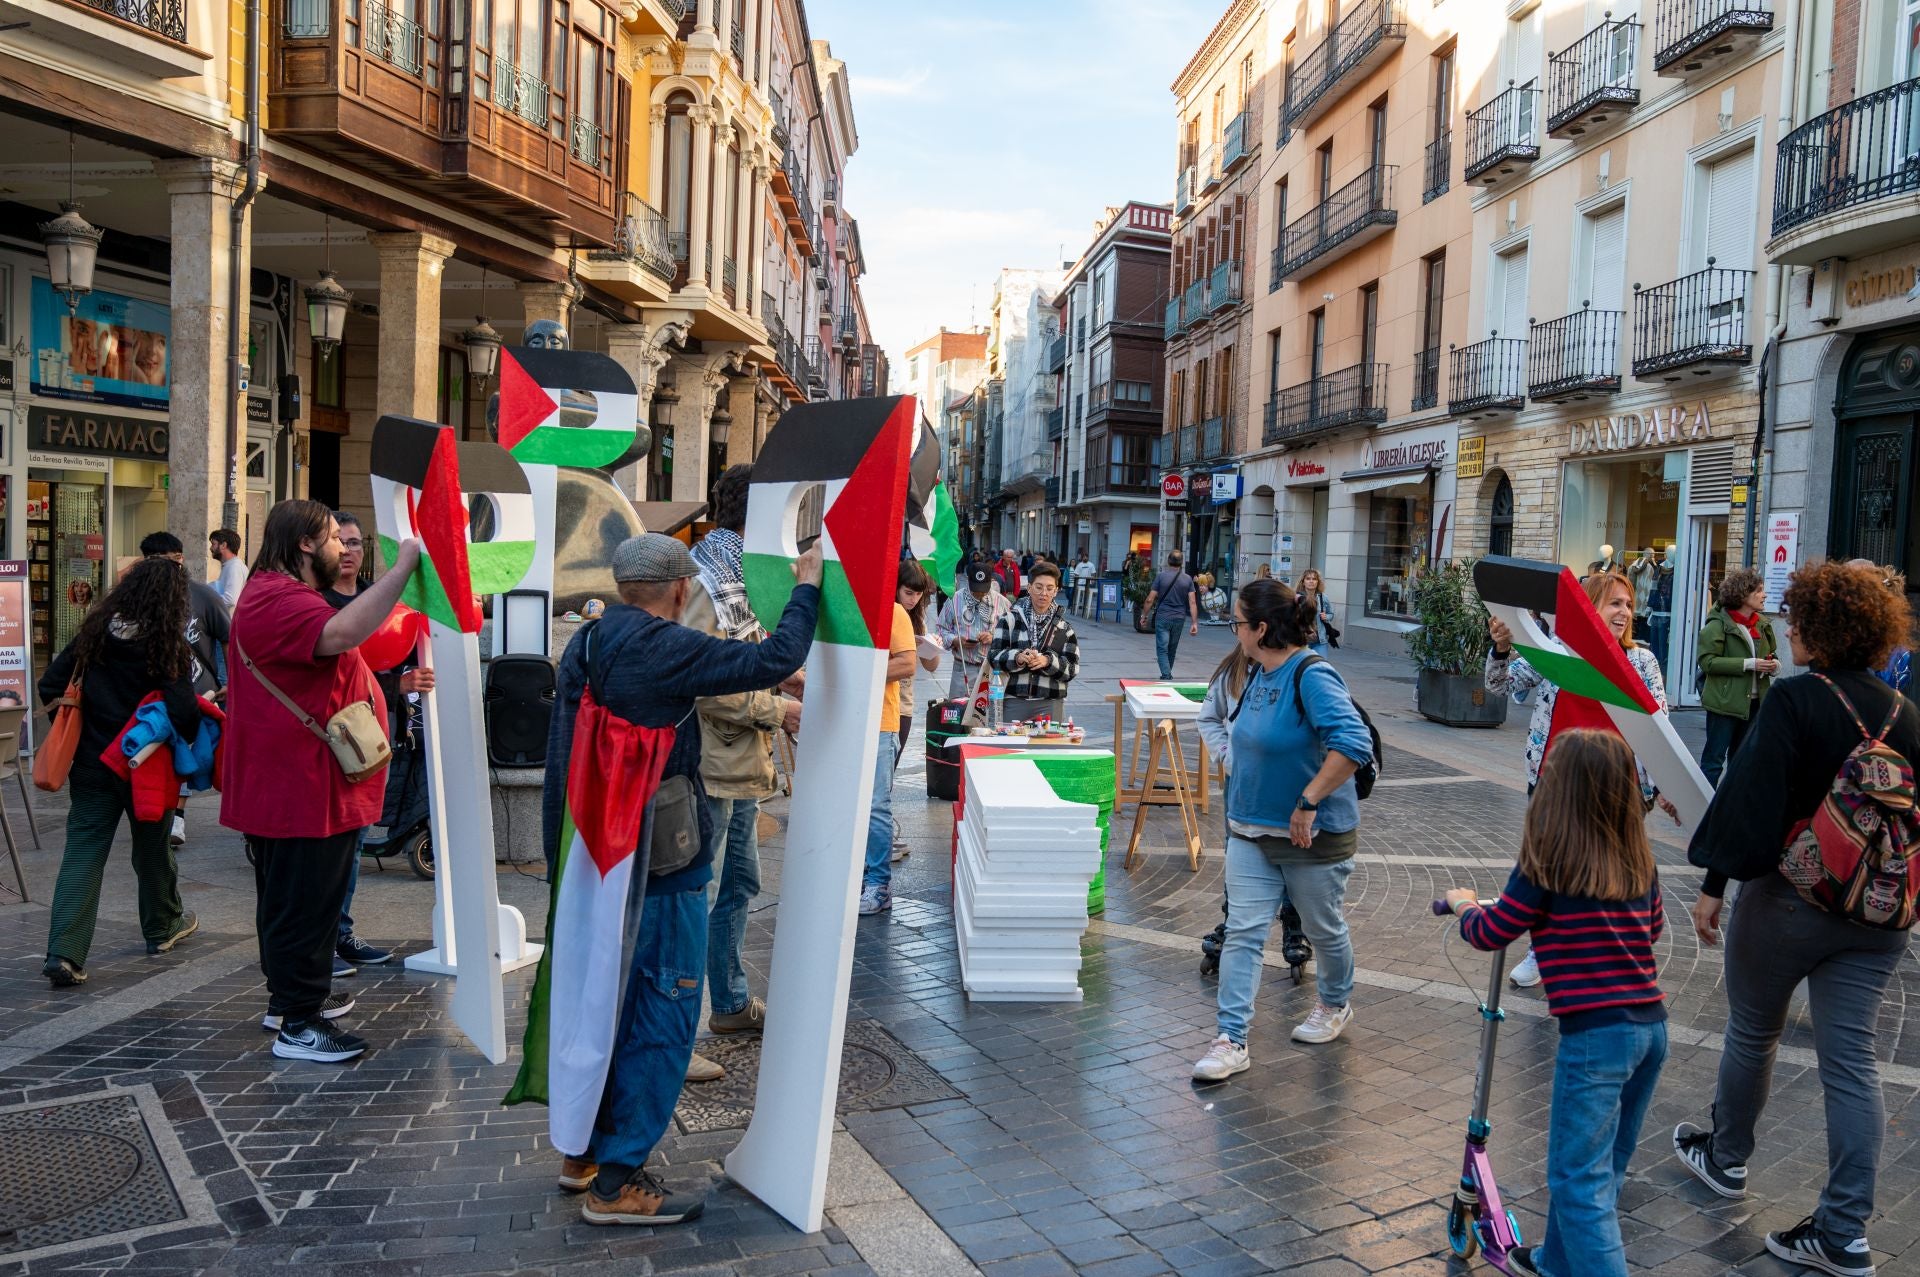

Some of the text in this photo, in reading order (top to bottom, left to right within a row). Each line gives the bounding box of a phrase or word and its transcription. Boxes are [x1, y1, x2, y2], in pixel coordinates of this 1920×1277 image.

[1845, 264, 1915, 308] CÁMARA
[1899, 357, 1912, 373] 59
[248, 409, 269, 418] Natural
[1568, 400, 1714, 455] DANDARA
[43, 455, 62, 464] Teresa
[1374, 440, 1446, 468] LIBRERÍA IGLESIAS
[1295, 459, 1315, 477] Halcón
[1165, 481, 1183, 490] BAR
[943, 709, 958, 718] ALTO
